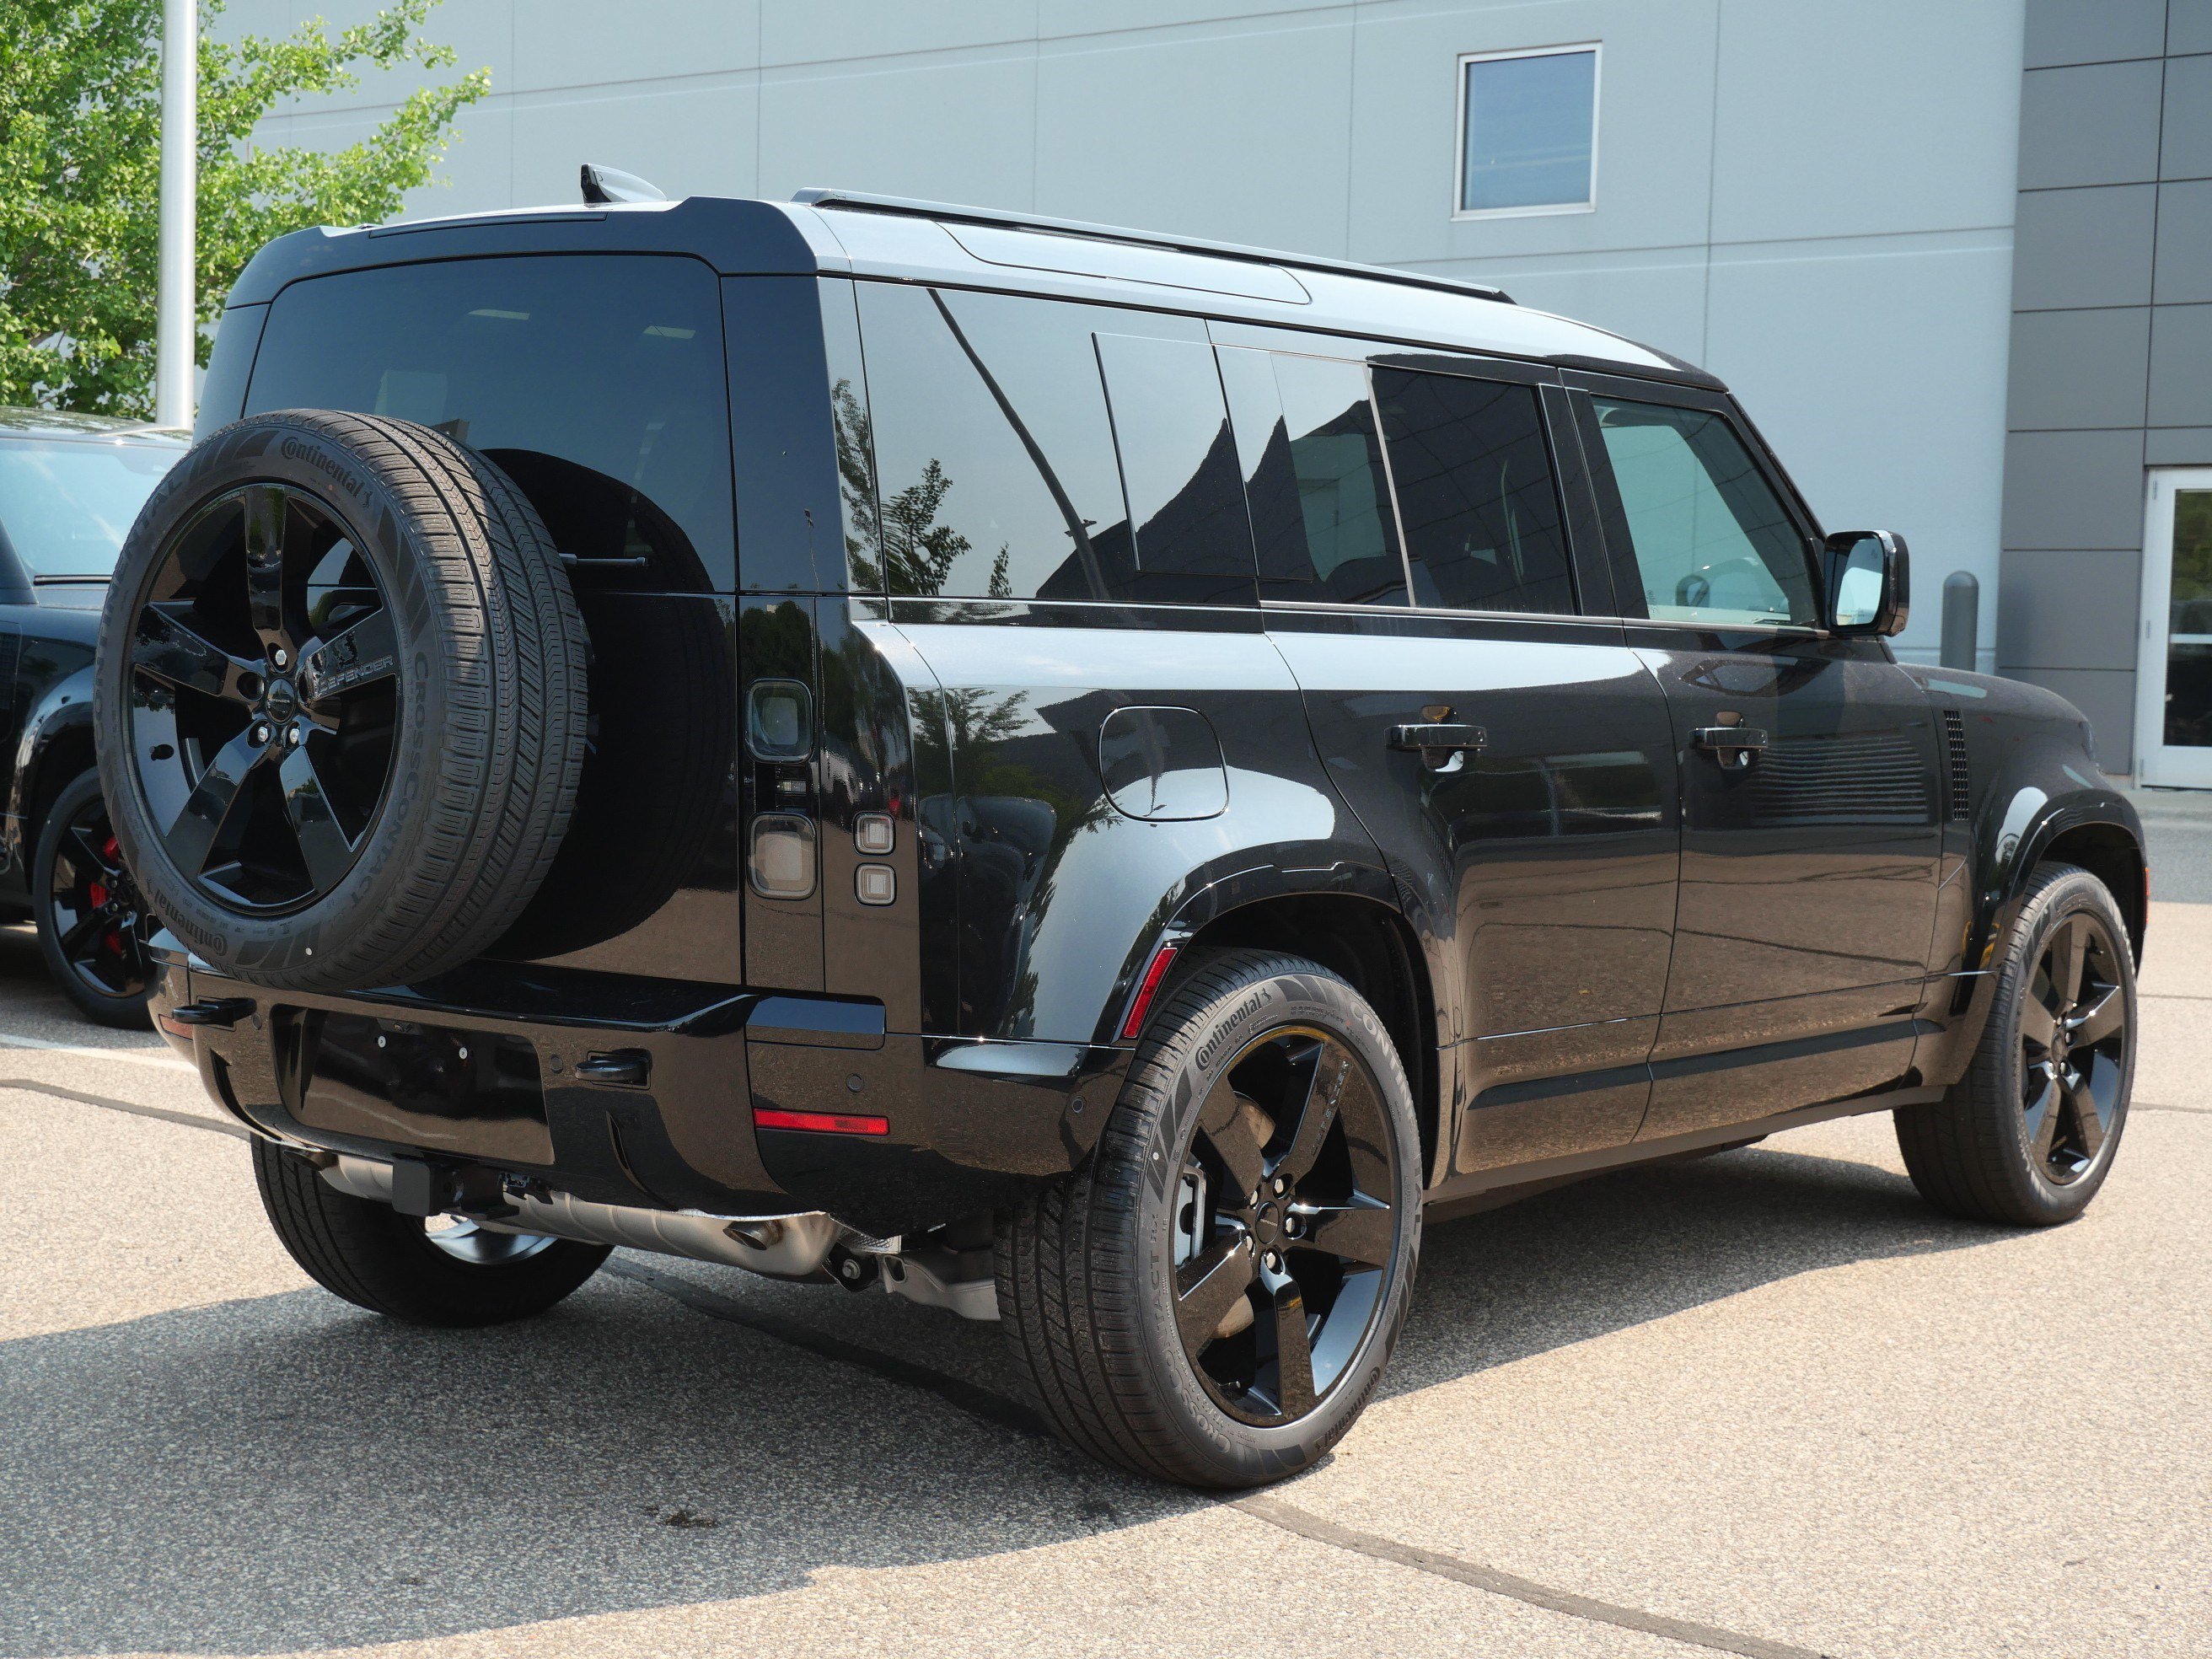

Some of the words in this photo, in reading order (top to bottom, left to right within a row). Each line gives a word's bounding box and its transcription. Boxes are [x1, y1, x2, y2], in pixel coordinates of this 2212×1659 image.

[281, 436, 365, 499] Continental
[319, 654, 394, 694] DEFENDER
[154, 889, 228, 956] Continental
[1195, 991, 1262, 1071] Continental
[1323, 1366, 1381, 1447] Continental
